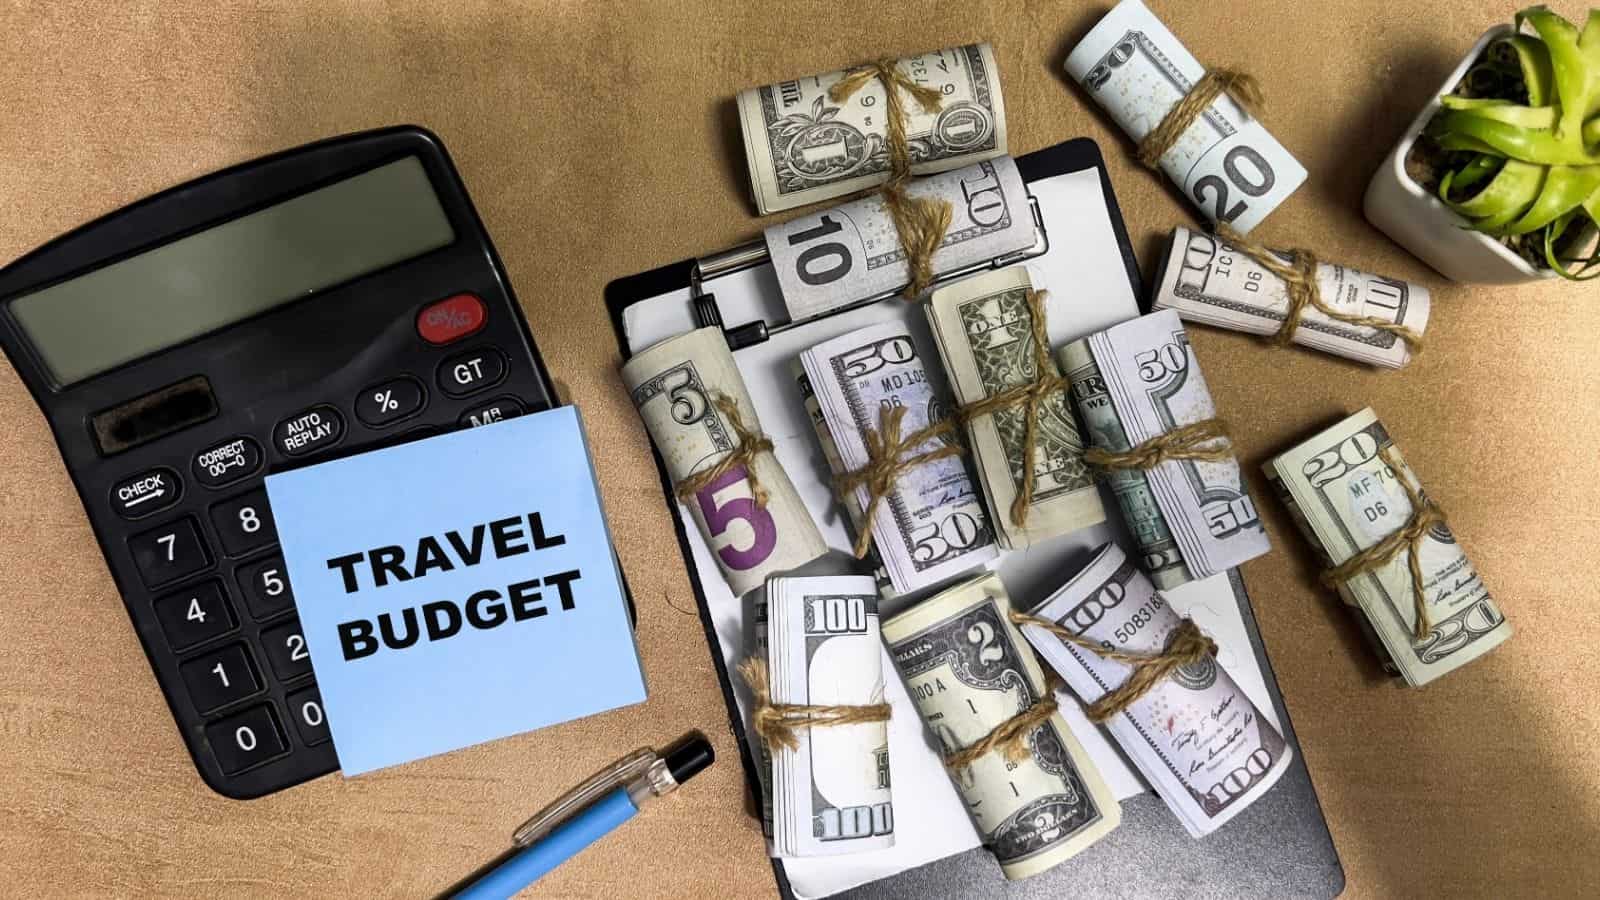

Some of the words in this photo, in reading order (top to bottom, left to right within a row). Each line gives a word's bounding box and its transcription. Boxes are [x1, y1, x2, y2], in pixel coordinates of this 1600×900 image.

[1192, 144, 1276, 224] 20
[787, 215, 852, 285] 10
[453, 358, 483, 384] GT
[841, 337, 915, 378] 50
[1134, 342, 1188, 383] 50
[374, 390, 399, 413] %
[662, 366, 708, 425] 5
[284, 422, 332, 450] REPLAY
[287, 413, 321, 436] AUTO
[199, 440, 245, 467] CORRECT
[1302, 431, 1378, 489] 20
[118, 474, 165, 501] CHECK
[239, 507, 261, 532] 8
[696, 462, 777, 570] 5
[1200, 494, 1258, 540] 50
[1363, 501, 1389, 523] D6
[157, 533, 177, 561] 7
[327, 511, 566, 594] TRAVEL
[910, 512, 979, 564] 50
[262, 569, 284, 596] 5
[186, 598, 207, 623] 4
[337, 569, 582, 662] BUDGET
[811, 597, 867, 634] 100
[1062, 580, 1126, 636] 100
[286, 634, 309, 661] 2
[967, 621, 1004, 666] 2
[1414, 598, 1505, 664] 20
[211, 662, 230, 688] 1
[235, 726, 257, 751] 0
[1205, 747, 1273, 806] 100
[819, 802, 894, 842] 100
